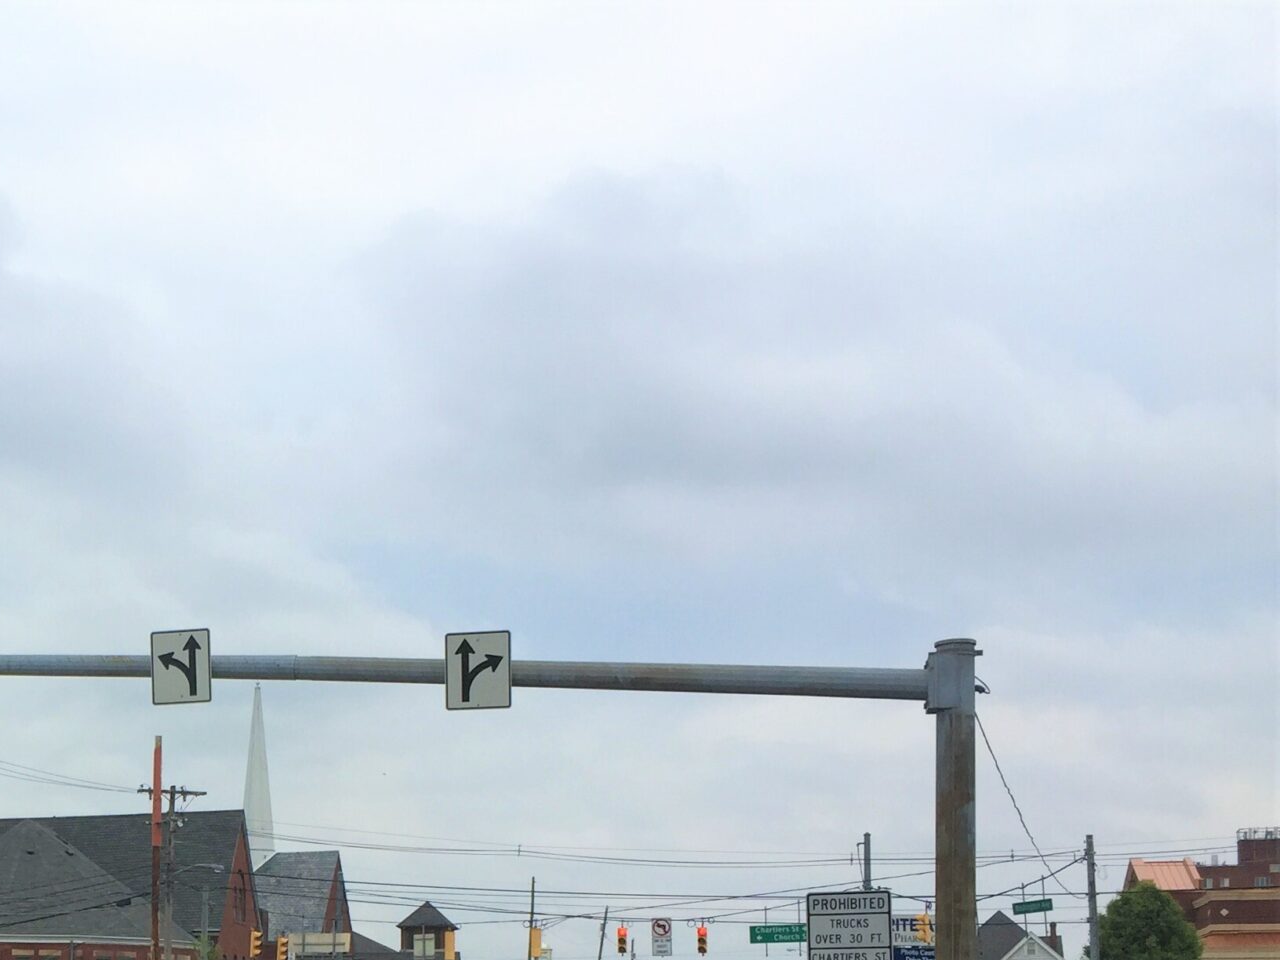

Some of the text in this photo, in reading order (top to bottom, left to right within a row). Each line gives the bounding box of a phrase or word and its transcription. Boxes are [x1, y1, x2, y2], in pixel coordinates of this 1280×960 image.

[812, 897, 885, 910] PROHIBITED
[830, 918, 870, 929] TRUCKS
[815, 934, 842, 944] OVER
[849, 933, 863, 944] 30
